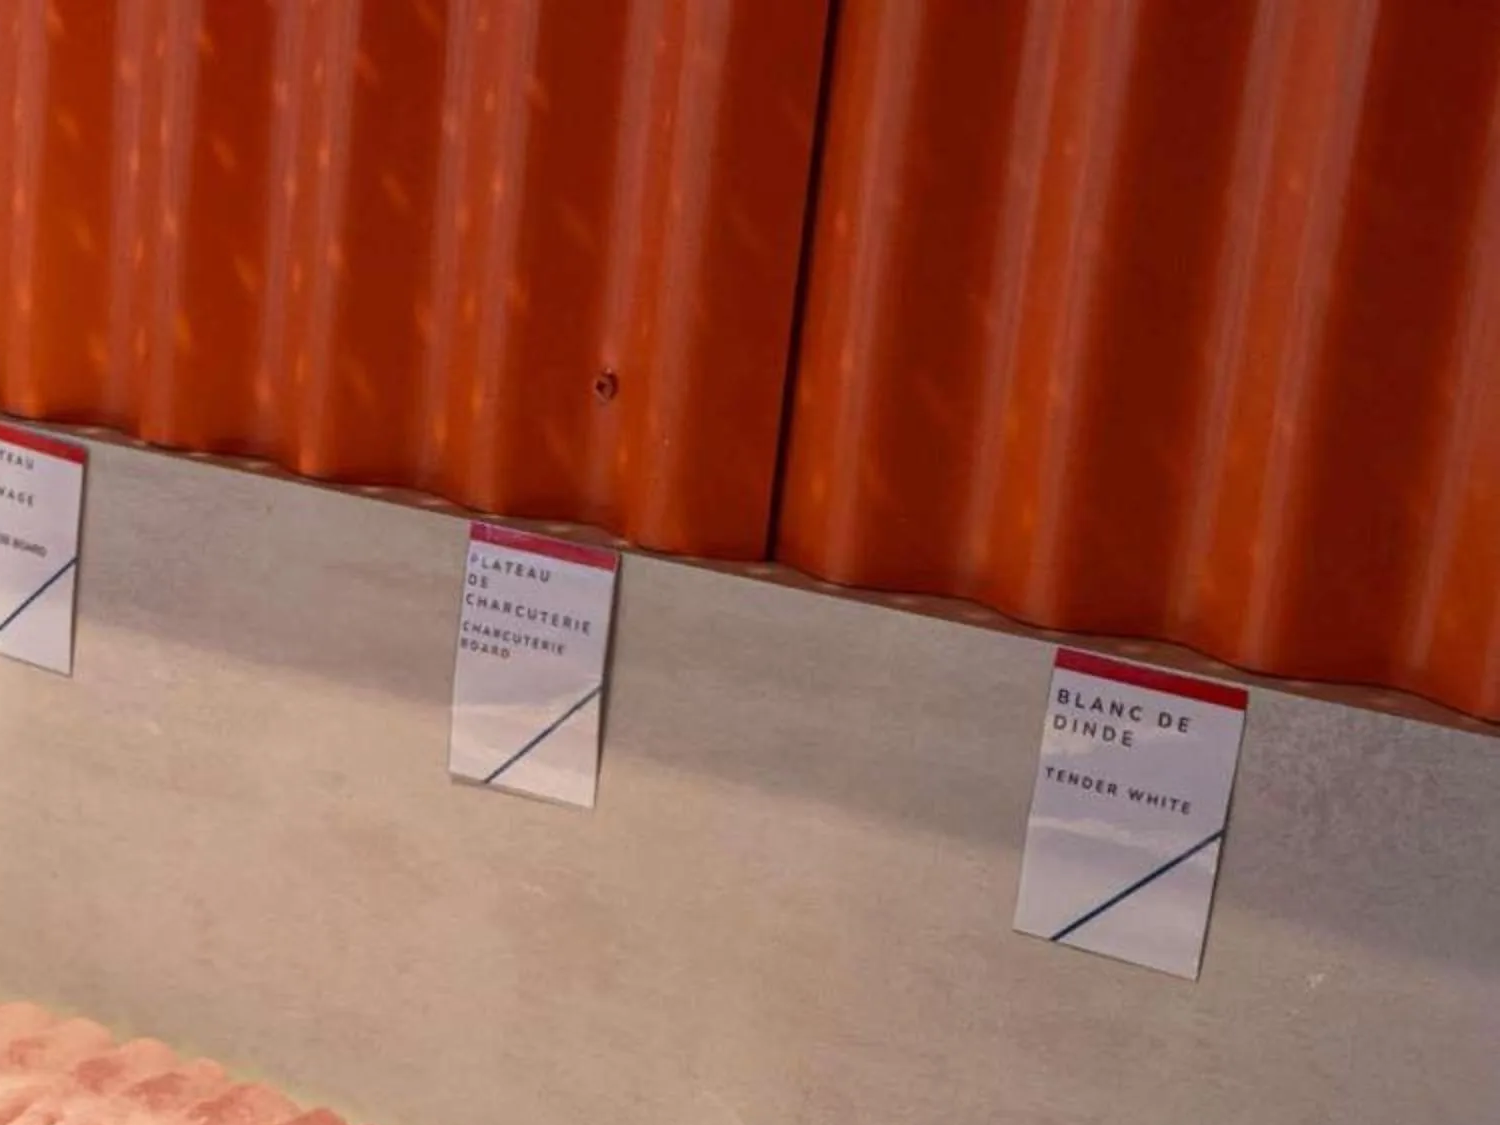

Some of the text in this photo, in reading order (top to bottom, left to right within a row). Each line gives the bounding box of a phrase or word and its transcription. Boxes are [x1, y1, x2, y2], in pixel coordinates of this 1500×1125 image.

[468, 574, 488, 588] DE
[469, 554, 551, 583] PLATEAU
[465, 594, 591, 634] CHARCUTERIE
[461, 638, 510, 659] BOARD
[462, 619, 566, 656] CHARCUTERIE
[1057, 688, 1191, 733] BLANC DE
[1053, 714, 1134, 748] DINDE
[1045, 766, 1192, 816] TENDER WHITE
